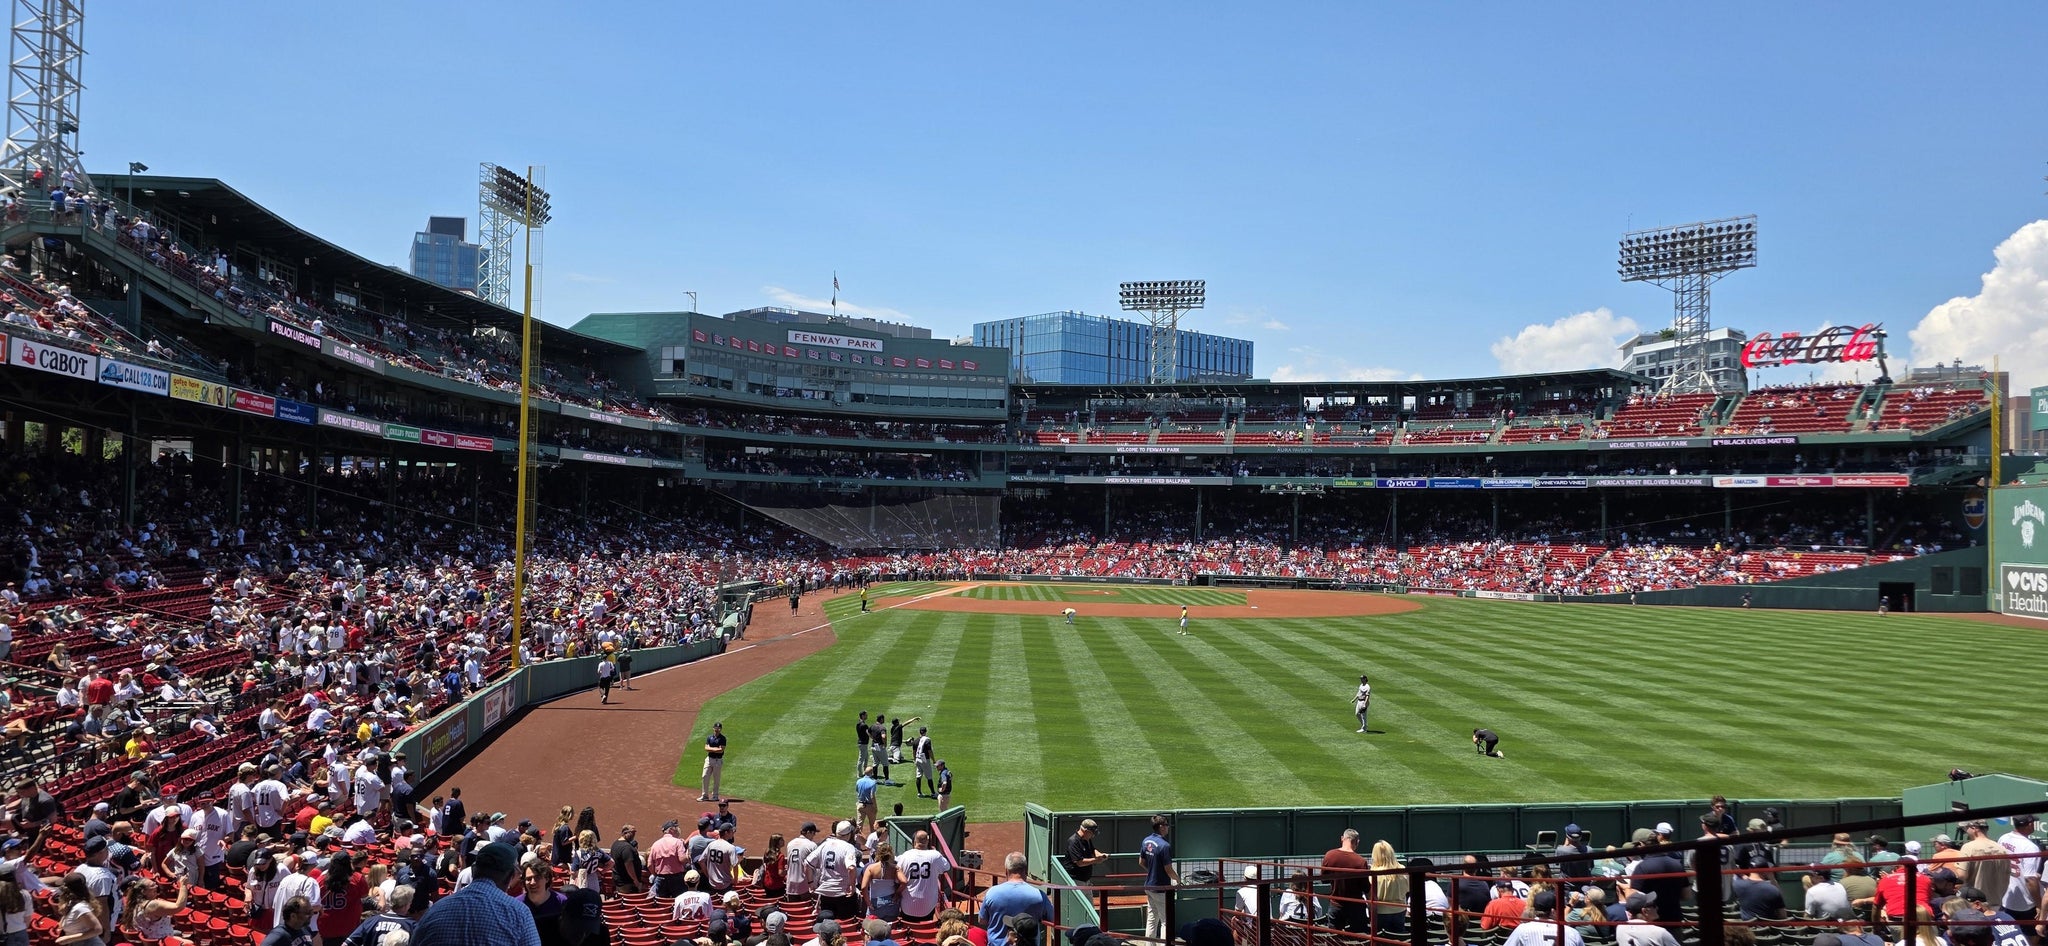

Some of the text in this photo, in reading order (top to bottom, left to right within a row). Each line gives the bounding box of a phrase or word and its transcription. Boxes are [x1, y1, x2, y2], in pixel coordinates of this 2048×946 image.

[279, 325, 320, 348] BLACK LIVES MATTER
[794, 333, 878, 349] FENWAY PARK
[1740, 322, 1883, 368] Coca-Cola
[334, 346, 349, 359] WELCOME
[354, 353, 366, 365] FENWAY
[366, 358, 374, 368] PARK
[124, 368, 167, 390] CALL128.COM
[188, 380, 200, 388] have
[324, 414, 341, 425] AMERICA'S
[342, 418, 351, 427] MOST
[351, 419, 364, 430] BELOVED
[365, 422, 380, 434] BALLPARK
[2012, 500, 2045, 526] JIM BEAM
[2020, 572, 2048, 592] CVS
[2009, 592, 2048, 613] Health
[357, 780, 366, 795] 12
[260, 793, 270, 806] 11
[445, 805, 451, 816] 2
[710, 849, 724, 864] 99
[826, 851, 835, 870] 2
[910, 862, 930, 880] 23
[683, 896, 700, 905] ORTIZ
[1294, 902, 1305, 919] 4
